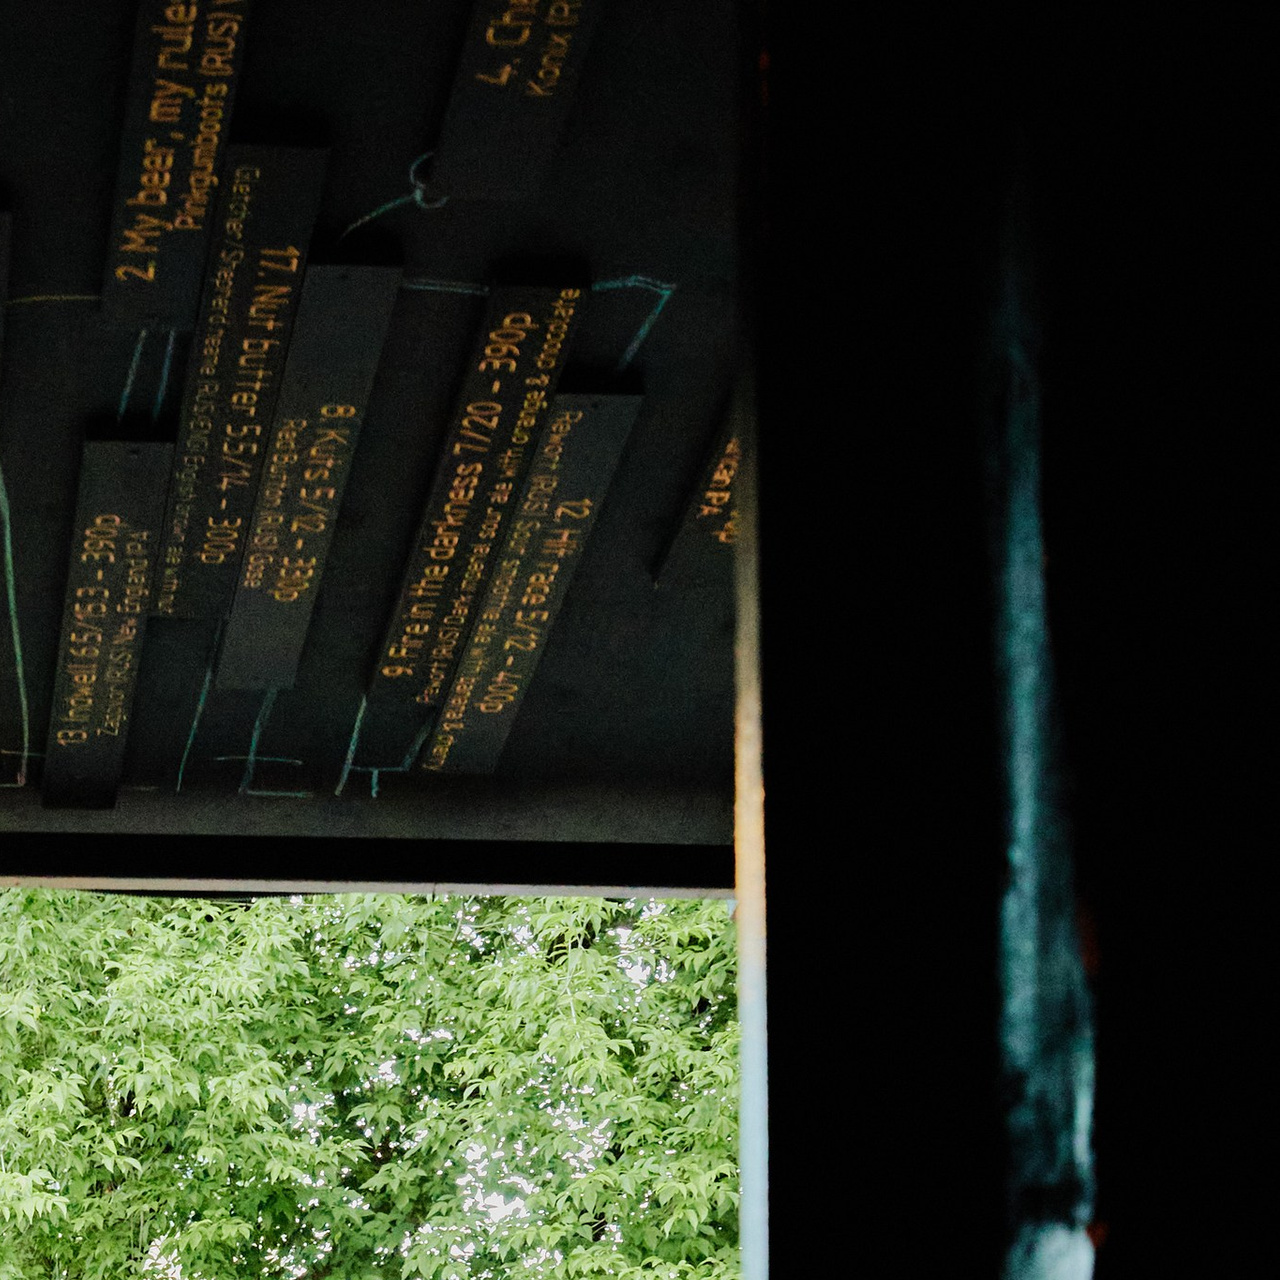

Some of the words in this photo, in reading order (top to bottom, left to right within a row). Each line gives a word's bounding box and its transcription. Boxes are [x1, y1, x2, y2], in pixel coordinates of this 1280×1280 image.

[152, 0, 197, 69] rule
[201, 12, 242, 76] (RUS)
[149, 79, 194, 122] my
[120, 214, 176, 252] My
[258, 246, 301, 276] 17.
[249, 285, 291, 331] Nut
[478, 313, 538, 372] 390p
[231, 339, 279, 417] butter
[453, 401, 502, 455] 7/20
[512, 390, 547, 443] orange
[424, 451, 483, 559] darkness
[81, 514, 127, 563] 390p
[195, 517, 241, 564] 300p
[409, 565, 449, 597] the
[522, 563, 559, 617] race
